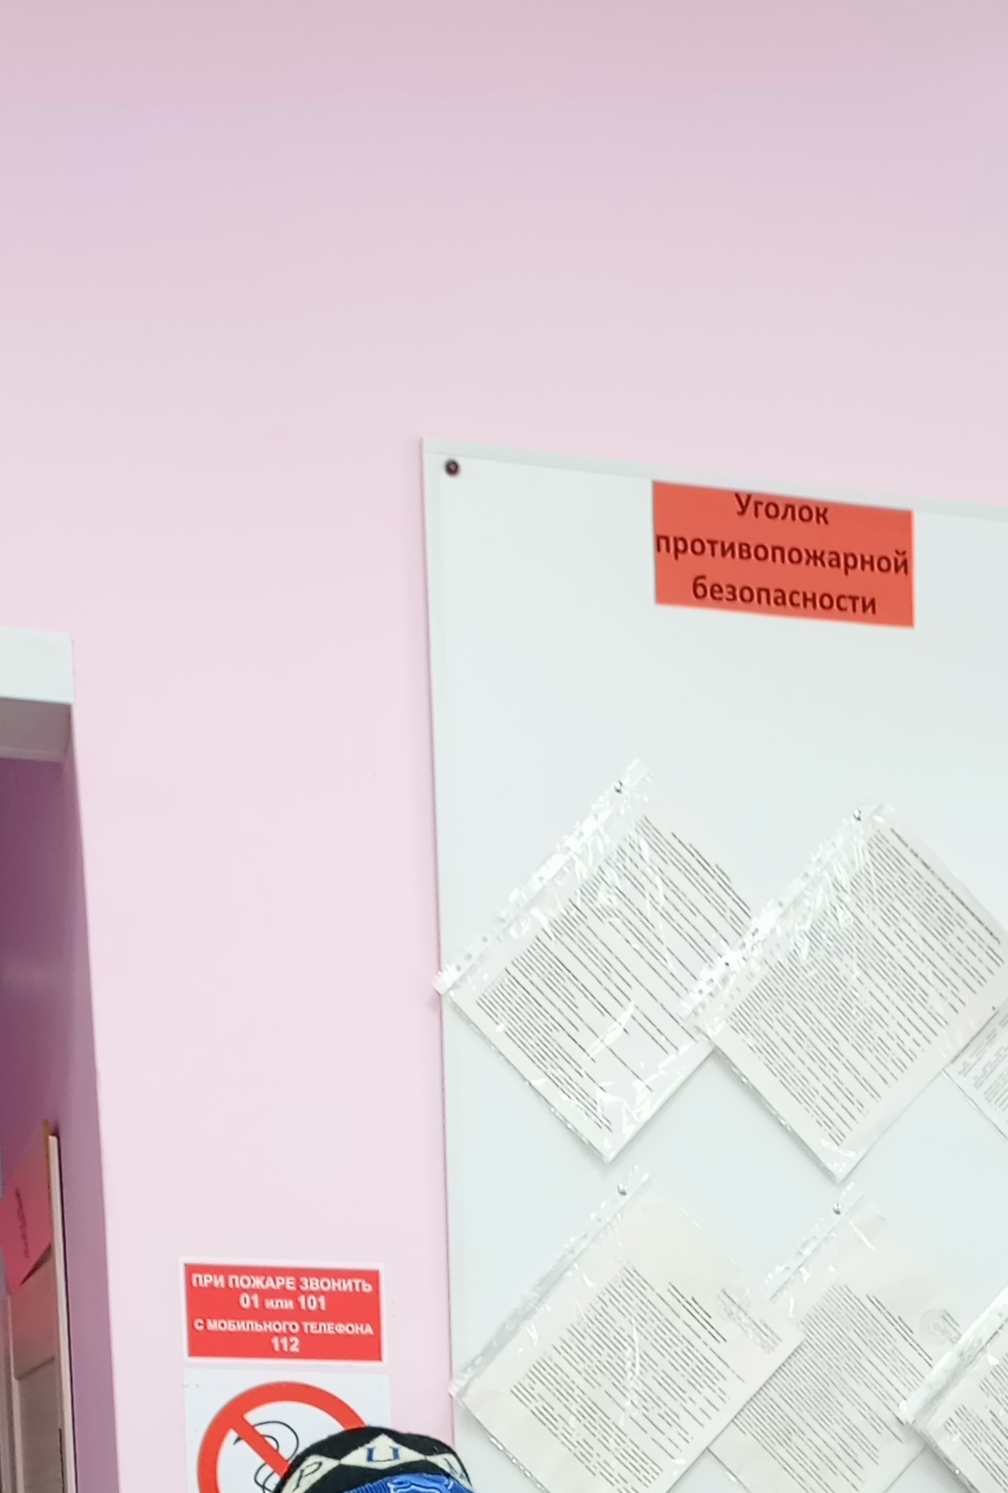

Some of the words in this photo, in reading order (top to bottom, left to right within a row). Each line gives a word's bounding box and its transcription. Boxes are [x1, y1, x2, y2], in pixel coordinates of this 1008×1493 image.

[733, 490, 831, 526] Уголок
[655, 531, 910, 577] противопожарной
[691, 575, 878, 617] безопасности
[191, 1273, 225, 1289] ПРИ
[228, 1274, 297, 1291] ПОЖАРЕ
[300, 1276, 373, 1293] ЗВОНИТЬ
[239, 1293, 260, 1309] 01
[264, 1298, 295, 1310] или
[297, 1295, 327, 1311] 101
[193, 1318, 205, 1331] С
[206, 1319, 300, 1334] МОБИЛЬНОГО
[302, 1321, 374, 1335] ТЕЛЕФОНА
[270, 1336, 301, 1353] 112
